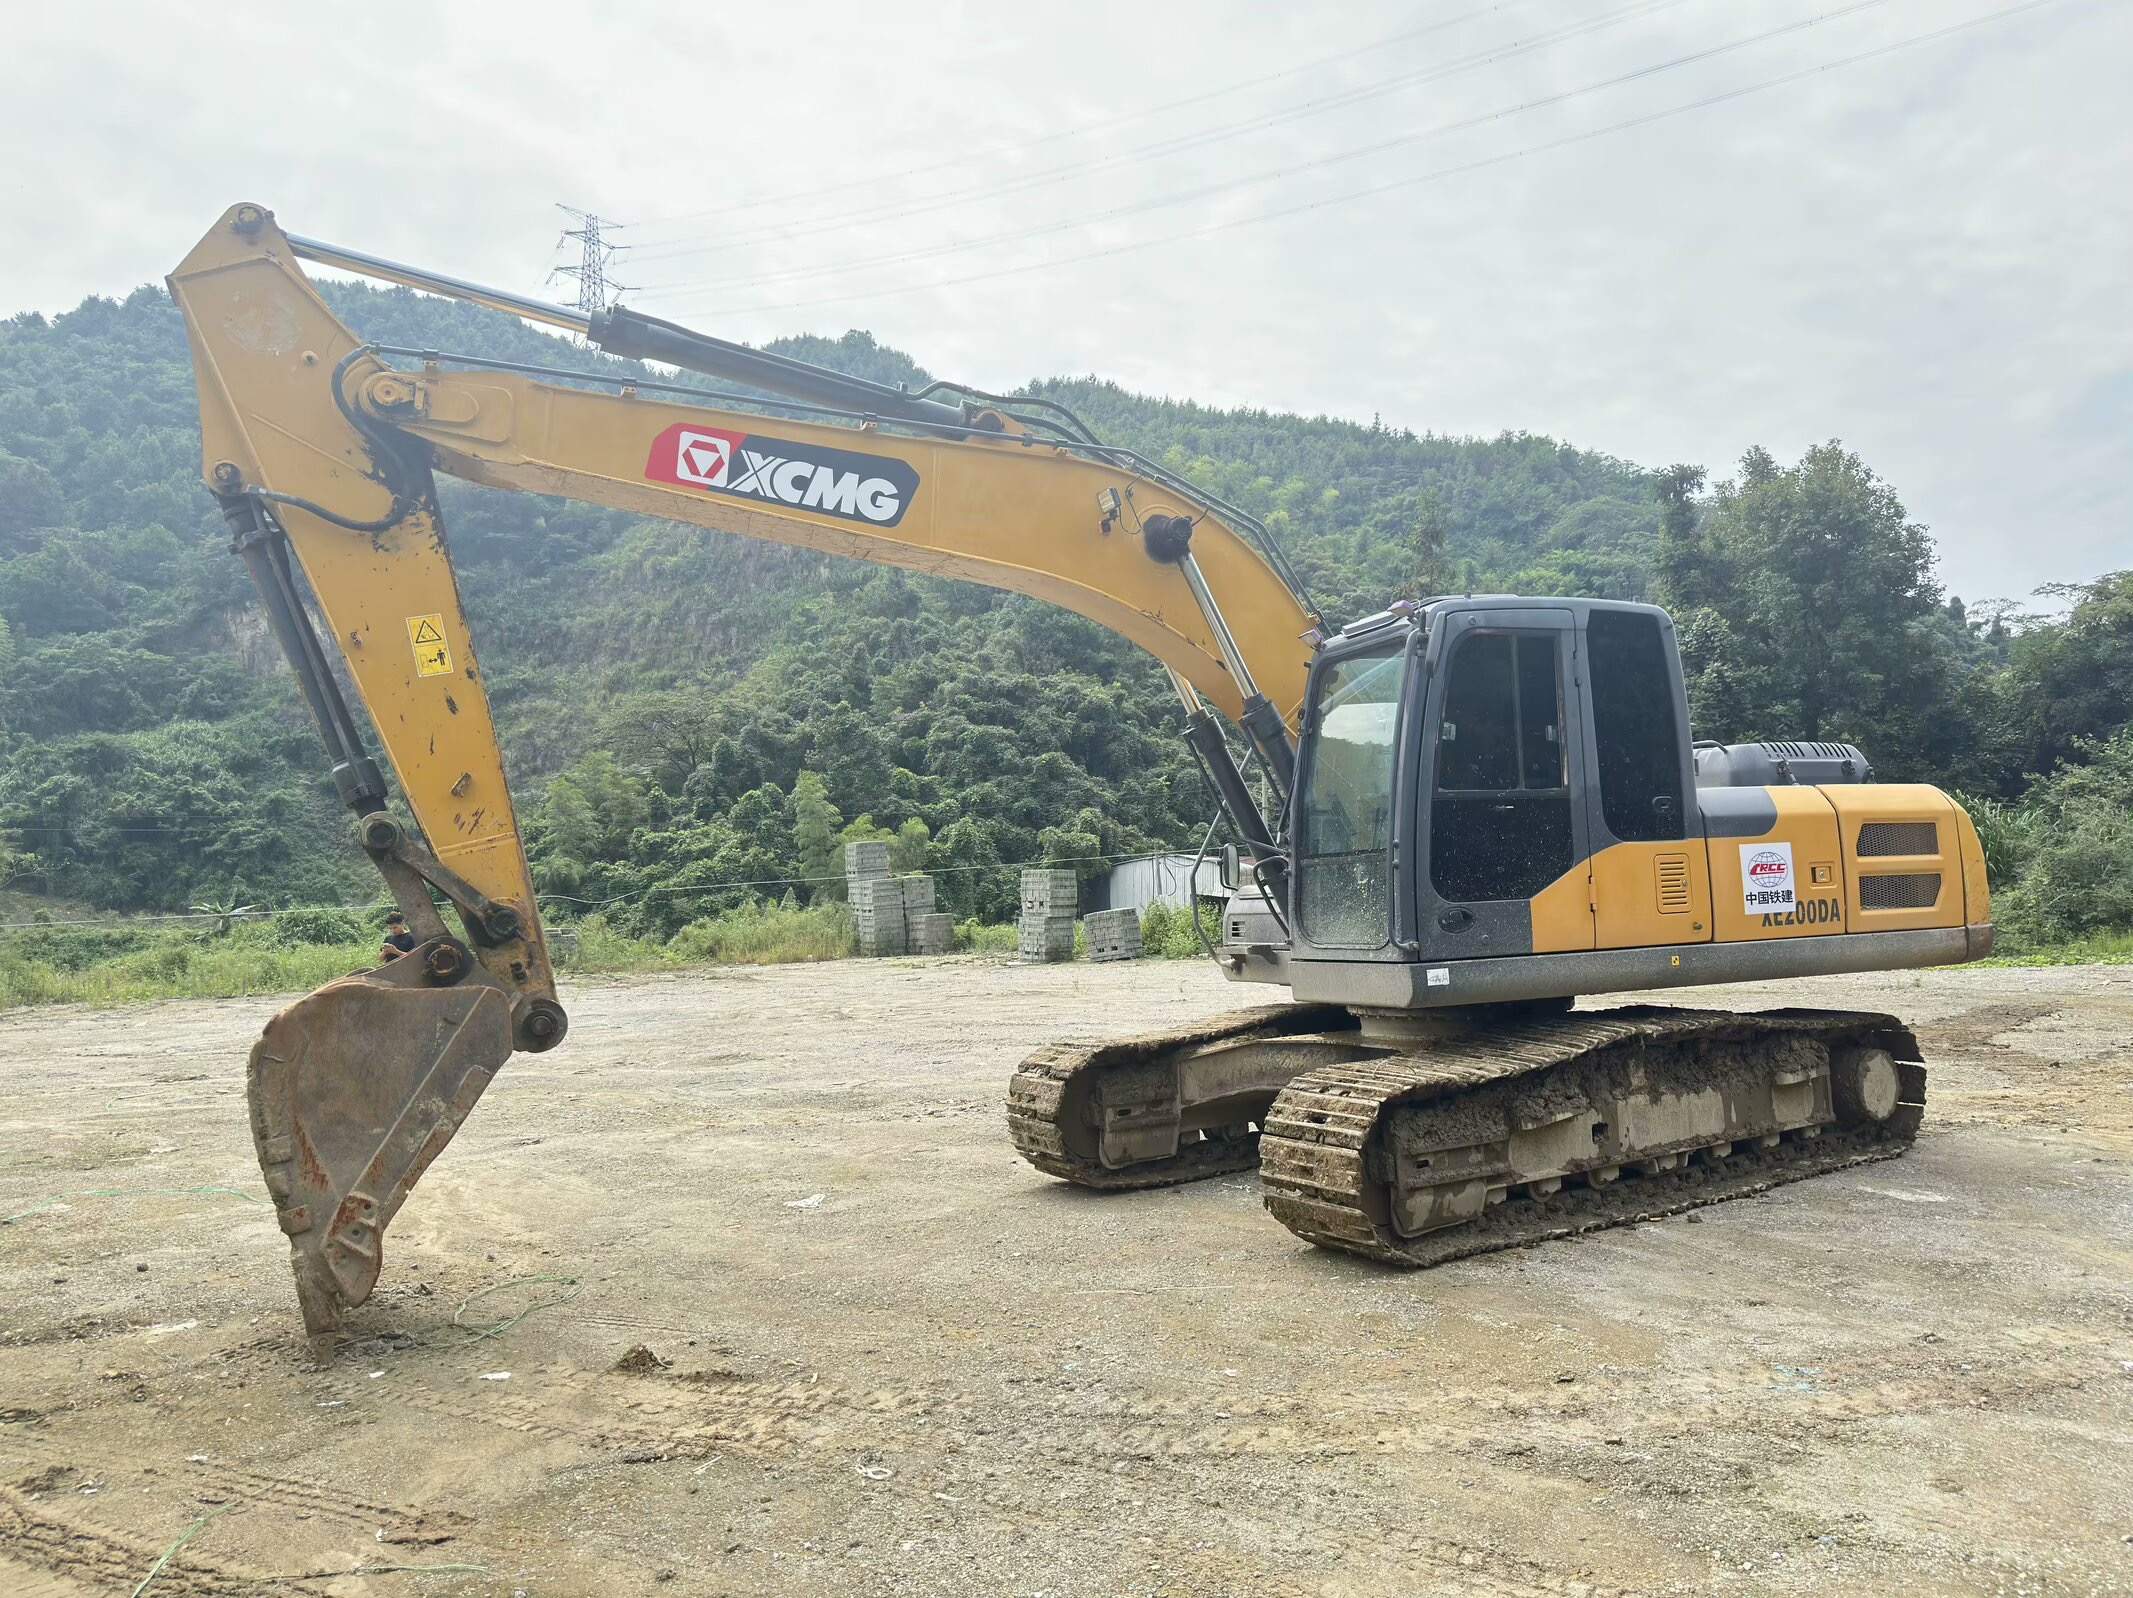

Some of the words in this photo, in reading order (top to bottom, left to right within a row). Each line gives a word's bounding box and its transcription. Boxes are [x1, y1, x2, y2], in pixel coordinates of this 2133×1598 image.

[727, 449, 899, 521] XCMG
[1750, 863, 1786, 875] CRCC
[1745, 889, 1793, 906] 中国铁建
